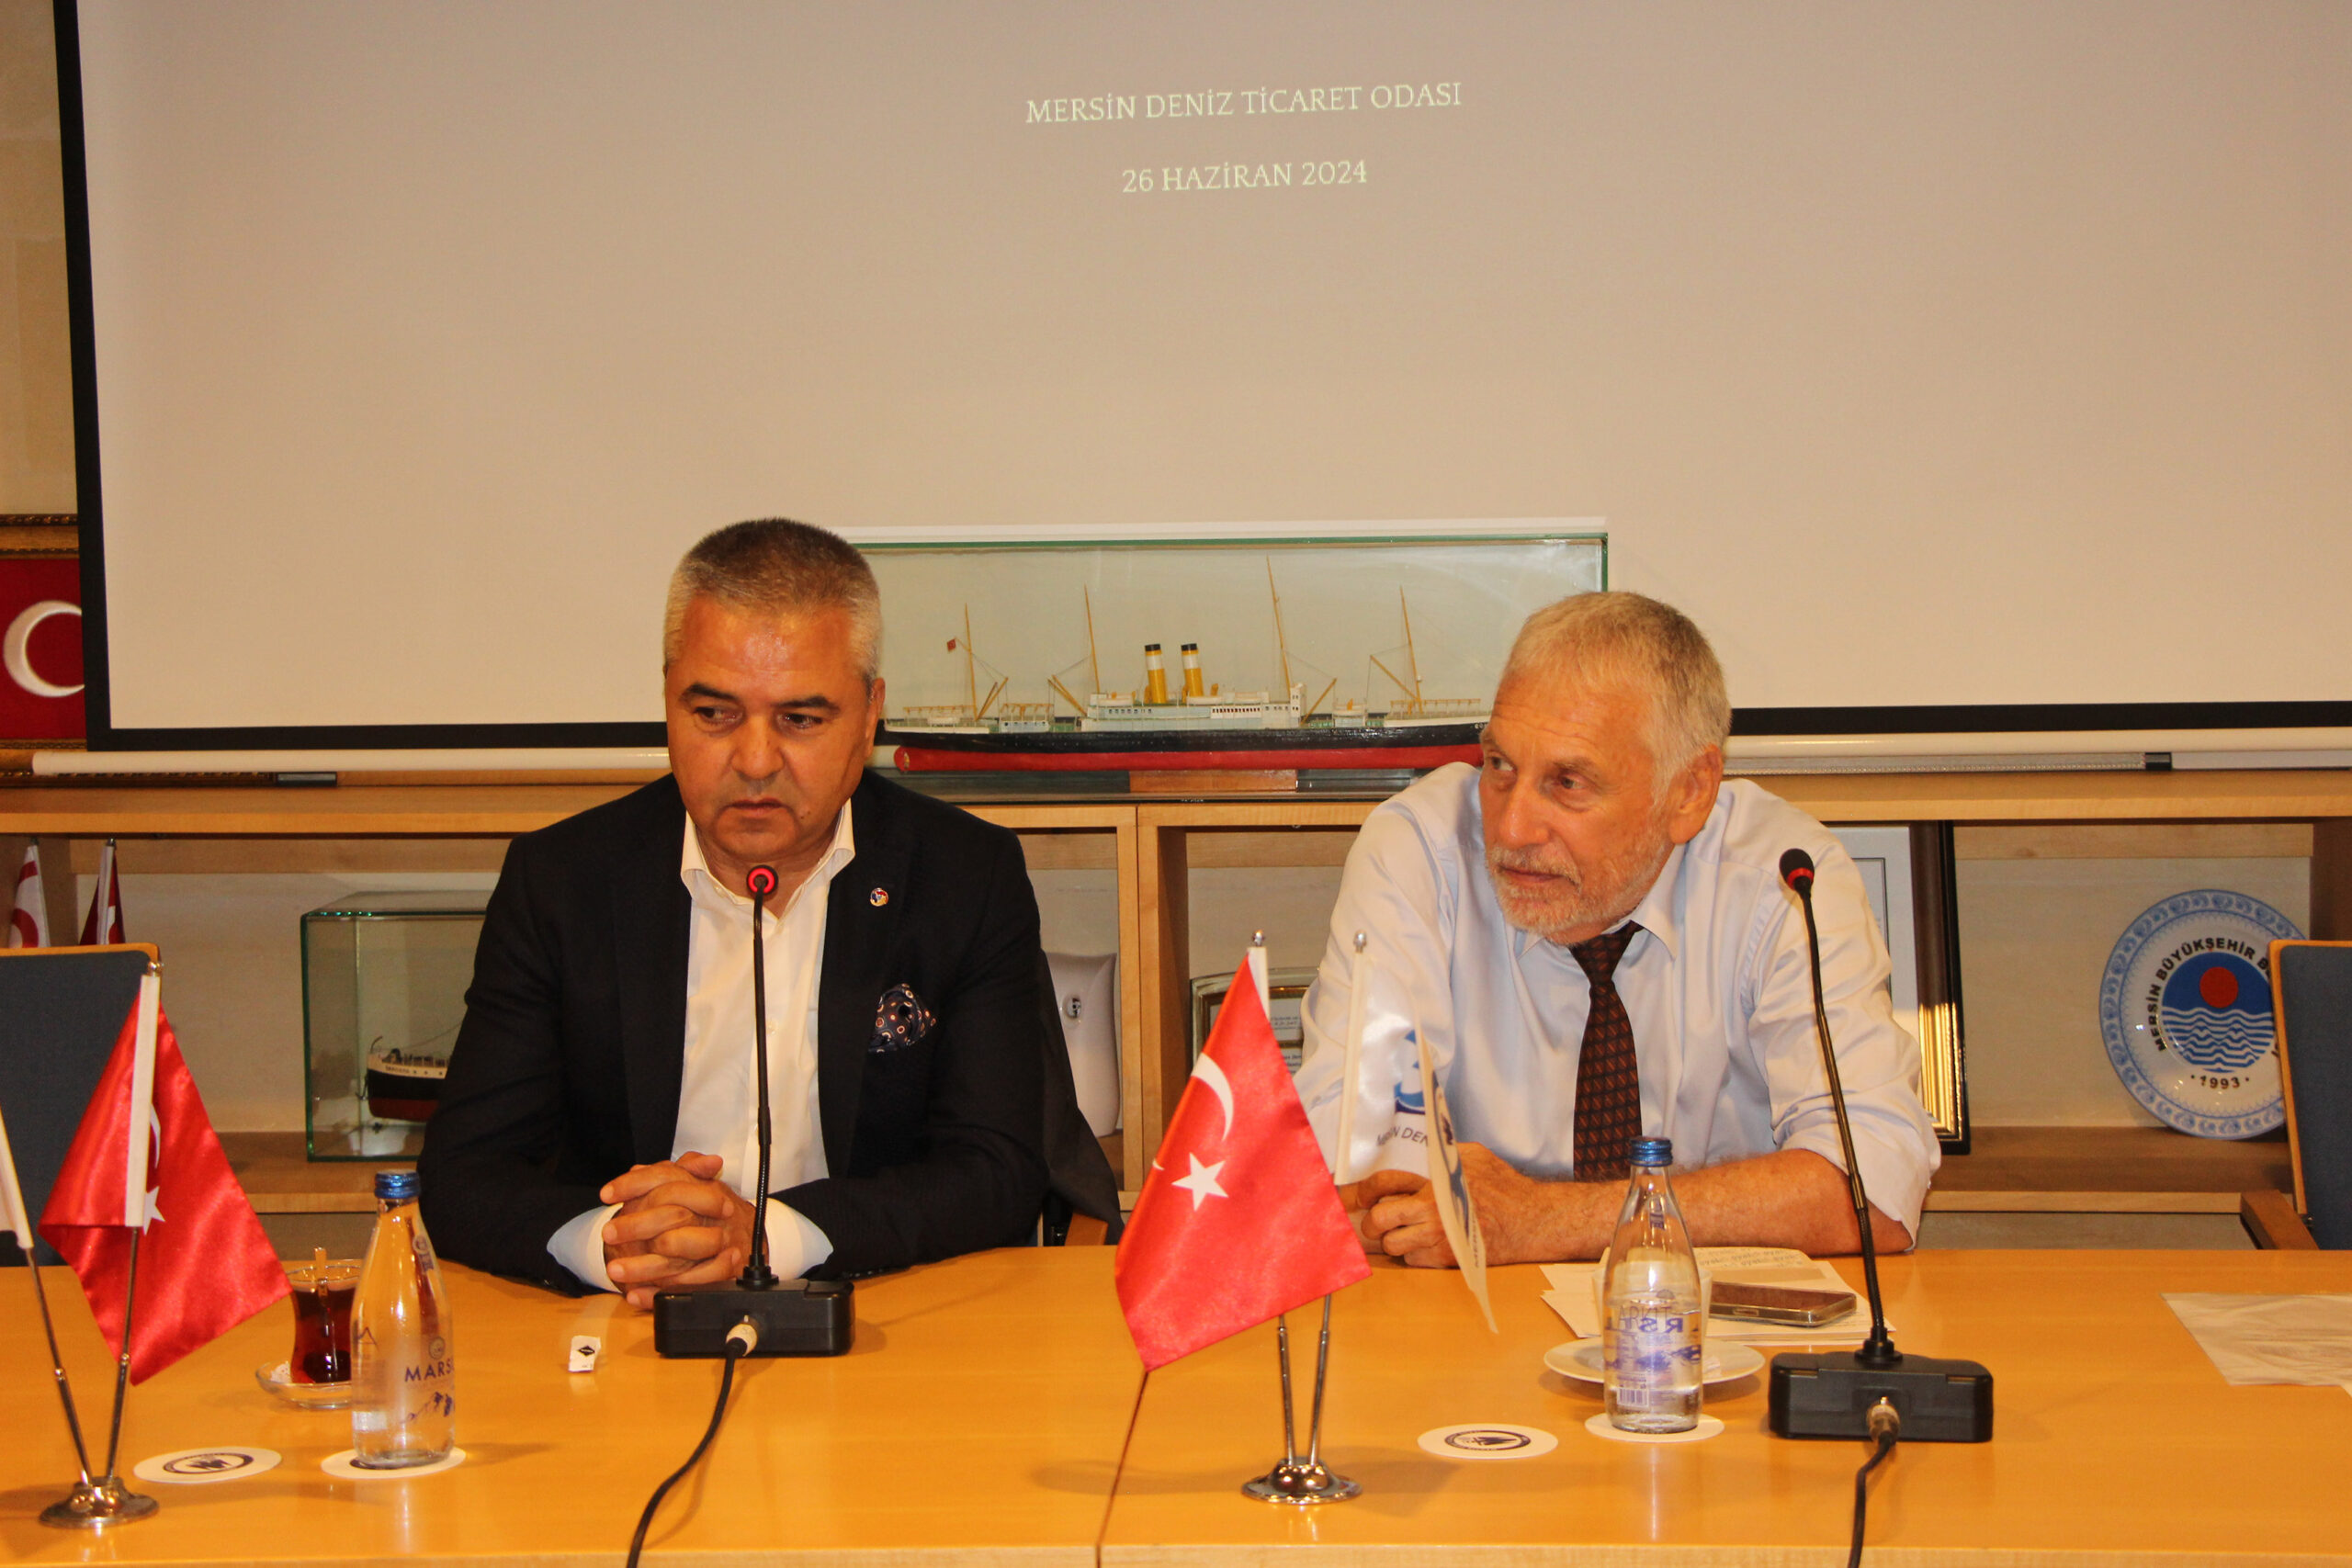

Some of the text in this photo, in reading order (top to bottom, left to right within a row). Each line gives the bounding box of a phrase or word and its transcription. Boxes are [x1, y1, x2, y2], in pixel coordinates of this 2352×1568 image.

[1025, 82, 1462, 124] MERSİN DENİZ TİCARET ODASI
[1122, 159, 1368, 194] 26 HAZİRAN 2024
[2145, 937, 2256, 1052] MERSİN BÜYÜKŞEHİR
[2200, 1075, 2240, 1089] 1993
